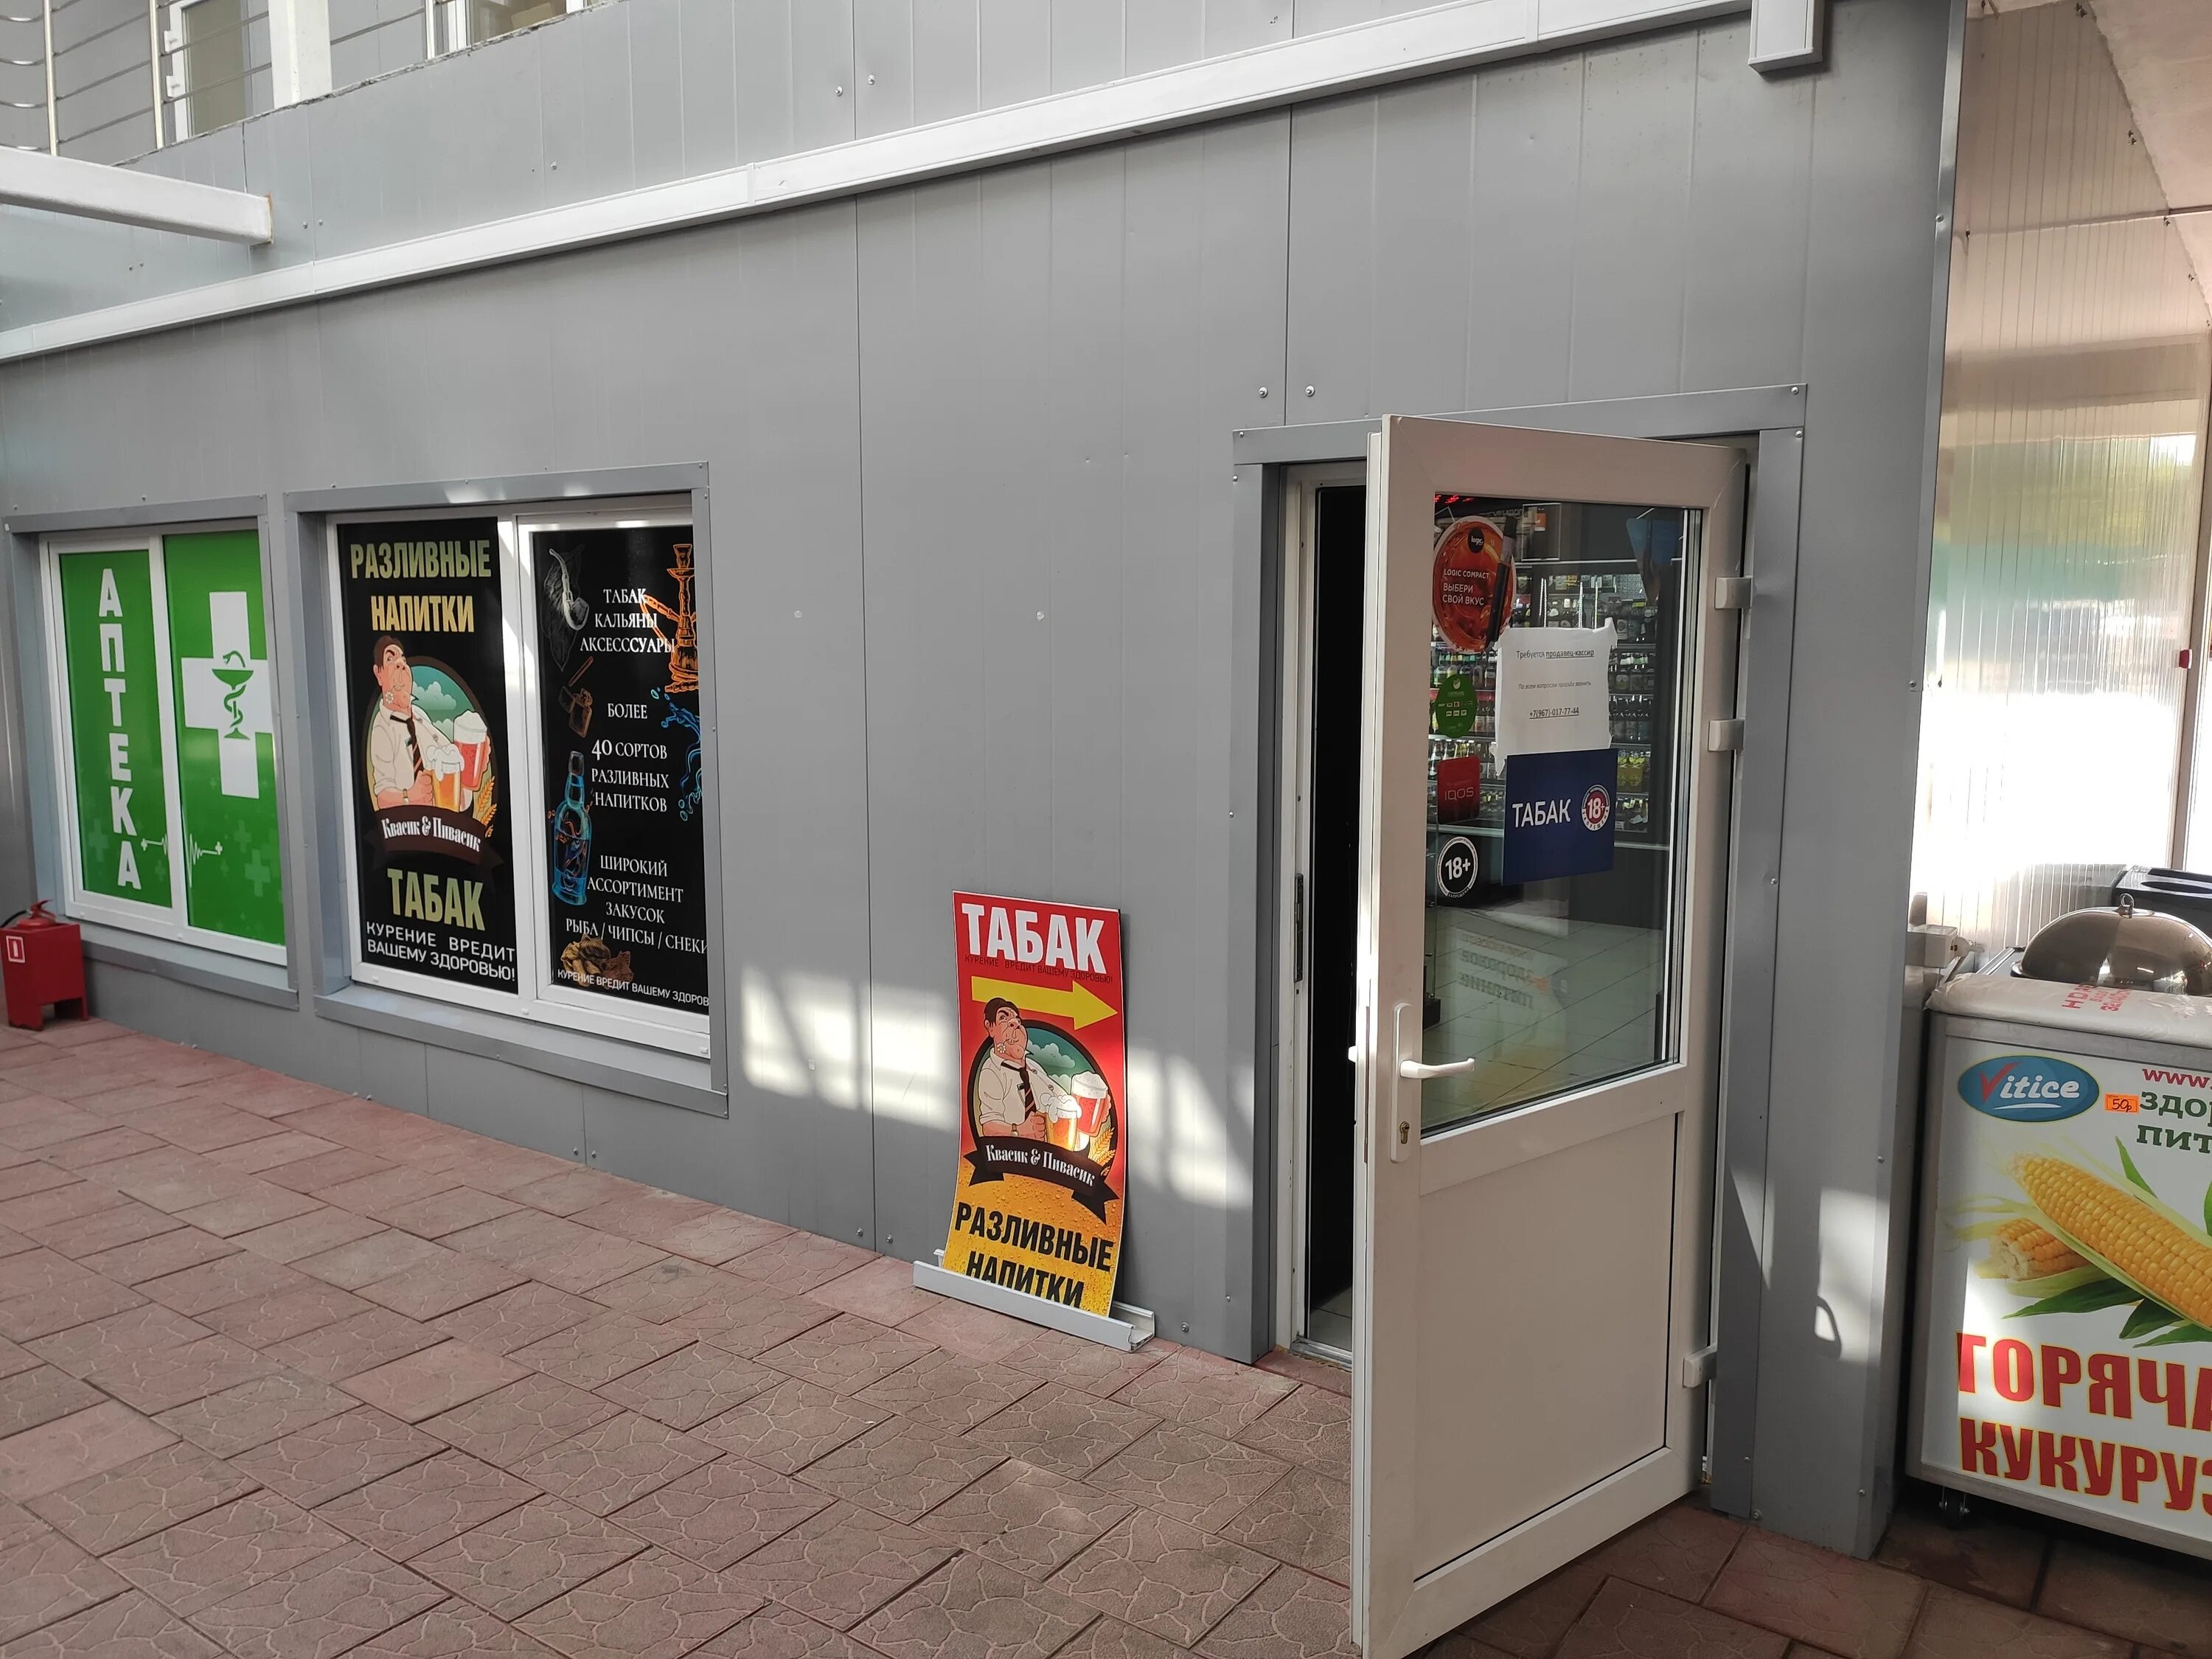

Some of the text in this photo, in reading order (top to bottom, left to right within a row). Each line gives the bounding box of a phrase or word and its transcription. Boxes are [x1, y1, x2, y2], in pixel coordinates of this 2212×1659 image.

[350, 540, 492, 579] РАЗЛИВНЫЕ
[1443, 568, 1490, 580] LOGIC COMPACT
[603, 588, 647, 604] ТАБАК
[1442, 594, 1484, 606] СВОЙ ВКУС
[1443, 583, 1474, 594] ВЫБЕРИ
[370, 595, 474, 633] НАПИТКИ
[594, 613, 658, 628] КАЛЬЯНЫ
[1516, 650, 1594, 659] Требуется продавец-кассир
[608, 703, 647, 719] БОЛЕЕ
[99, 568, 142, 889] АПТЕКА
[591, 739, 667, 761] 40 СОРТОВ
[591, 768, 669, 788] РАЗЛИВНЫХ
[595, 792, 667, 812] НАПИТКОВ
[1445, 787, 1474, 801] IQOS
[1587, 797, 1605, 819] 18+
[1512, 799, 1571, 828] ТАБАК
[381, 815, 481, 852] Квасик & Пивасик
[600, 855, 668, 877] ШИРОКИЙ
[1445, 857, 1471, 880] 18+
[387, 867, 485, 931] ТАБАК
[587, 877, 684, 903] АССОРТИМЕНТ
[605, 902, 665, 924] ЗАКУСОК
[366, 922, 515, 962] КУРЕНИЕ ВРЕДИТ
[566, 918, 598, 937] РЫБА
[608, 925, 655, 945] ЧИПСЫ
[961, 902, 1107, 975] ТАБАК
[367, 939, 515, 981] ВАШЕМУ ЗДОРОВЬЮ!
[964, 955, 1113, 984] КУРЕНИЕ ВРЕДИТ ВАШЕМУ ЗДОРОВЬЮ!
[557, 969, 595, 985] КУРЕНИЕ
[596, 975, 630, 992] ВРЕДИТ
[632, 983, 671, 999] ВАШЕМУ
[1979, 1062, 2080, 1104] Vitice
[2139, 1091, 2212, 1127] здо
[985, 1144, 1096, 1187] Квасик & Пивасик
[954, 1202, 1115, 1273] РАЗЛИВНЫЕ
[966, 1251, 1085, 1309] НАПИТКИ
[1959, 1416, 2212, 1517] КУКУРУ
